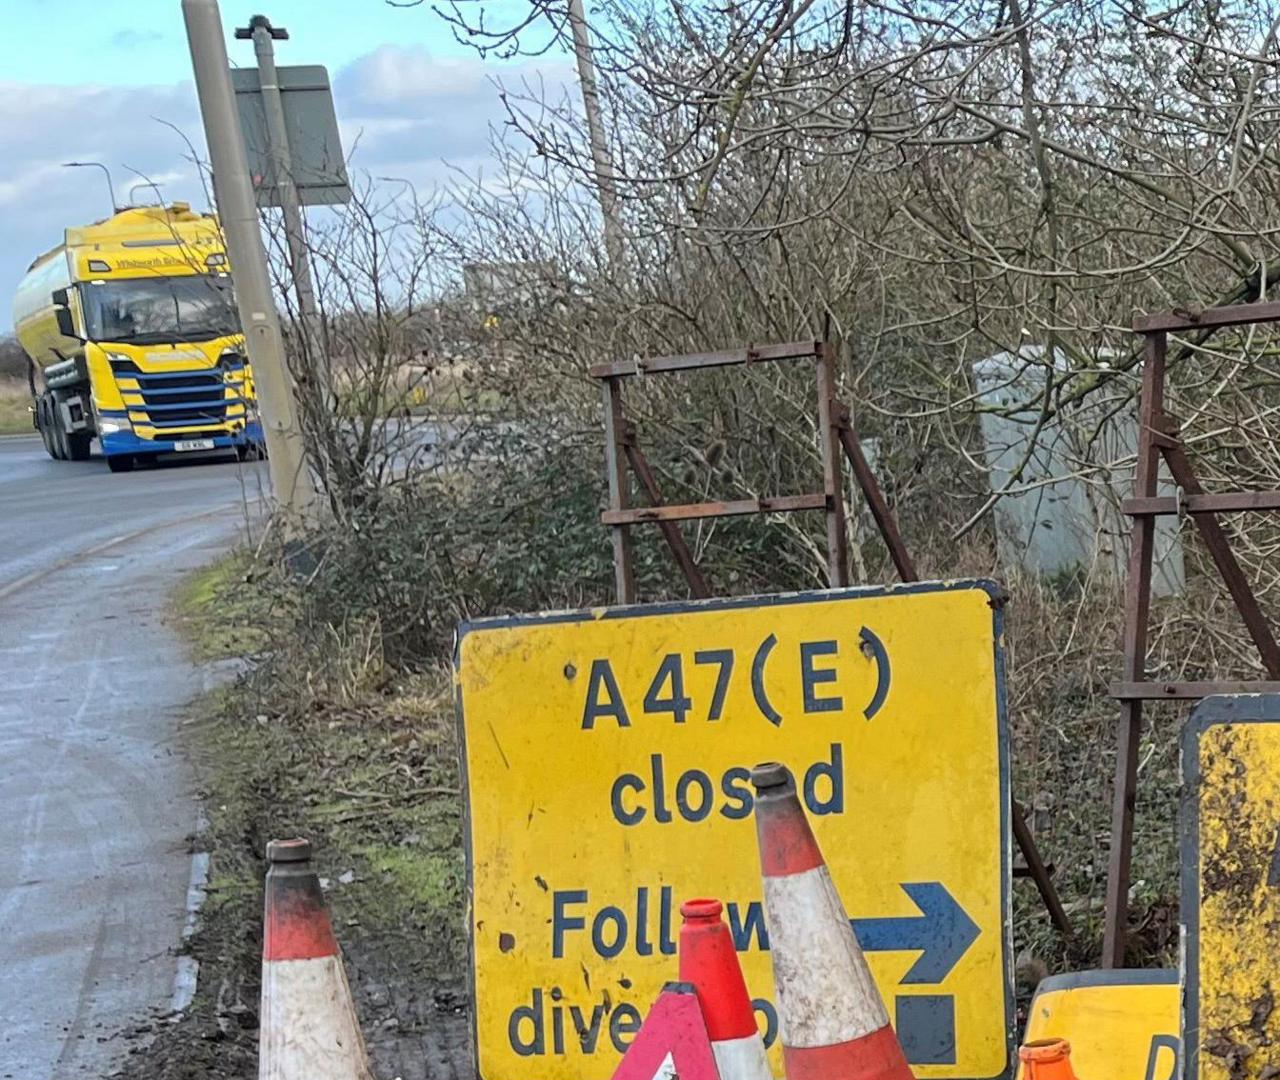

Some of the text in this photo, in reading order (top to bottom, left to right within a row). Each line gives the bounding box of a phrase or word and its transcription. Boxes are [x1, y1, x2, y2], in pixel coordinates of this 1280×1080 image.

[581, 626, 891, 731] A47(E)
[611, 743, 844, 827] closd
[551, 885, 771, 960] Follw
